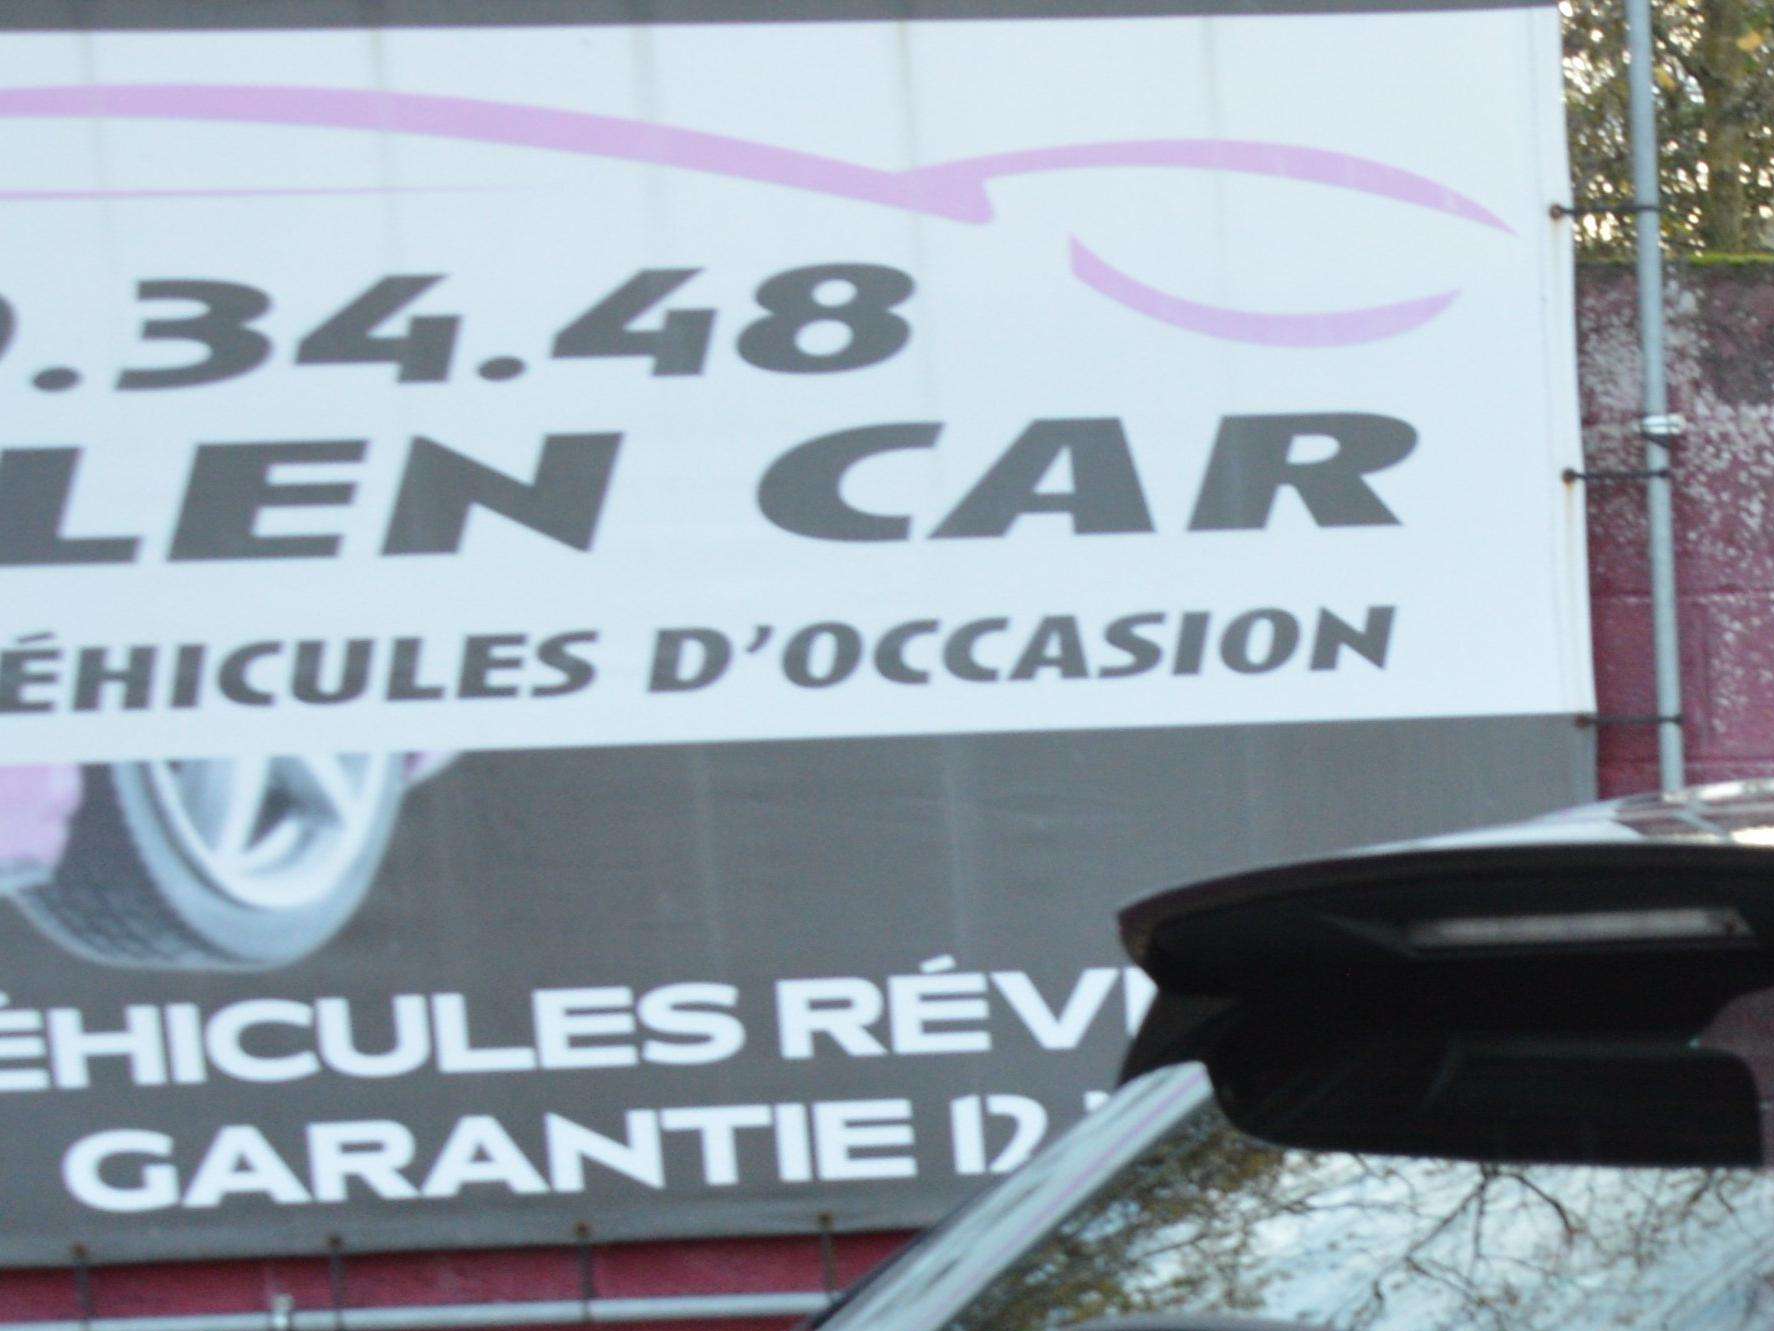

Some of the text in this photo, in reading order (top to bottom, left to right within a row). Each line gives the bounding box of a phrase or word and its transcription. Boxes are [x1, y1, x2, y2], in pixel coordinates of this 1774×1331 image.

[0, 262, 918, 392] .34.48
[756, 410, 1420, 544] CAR
[646, 604, 1397, 695] D'OCCASION
[61, 1096, 918, 1214] GARANTIE
